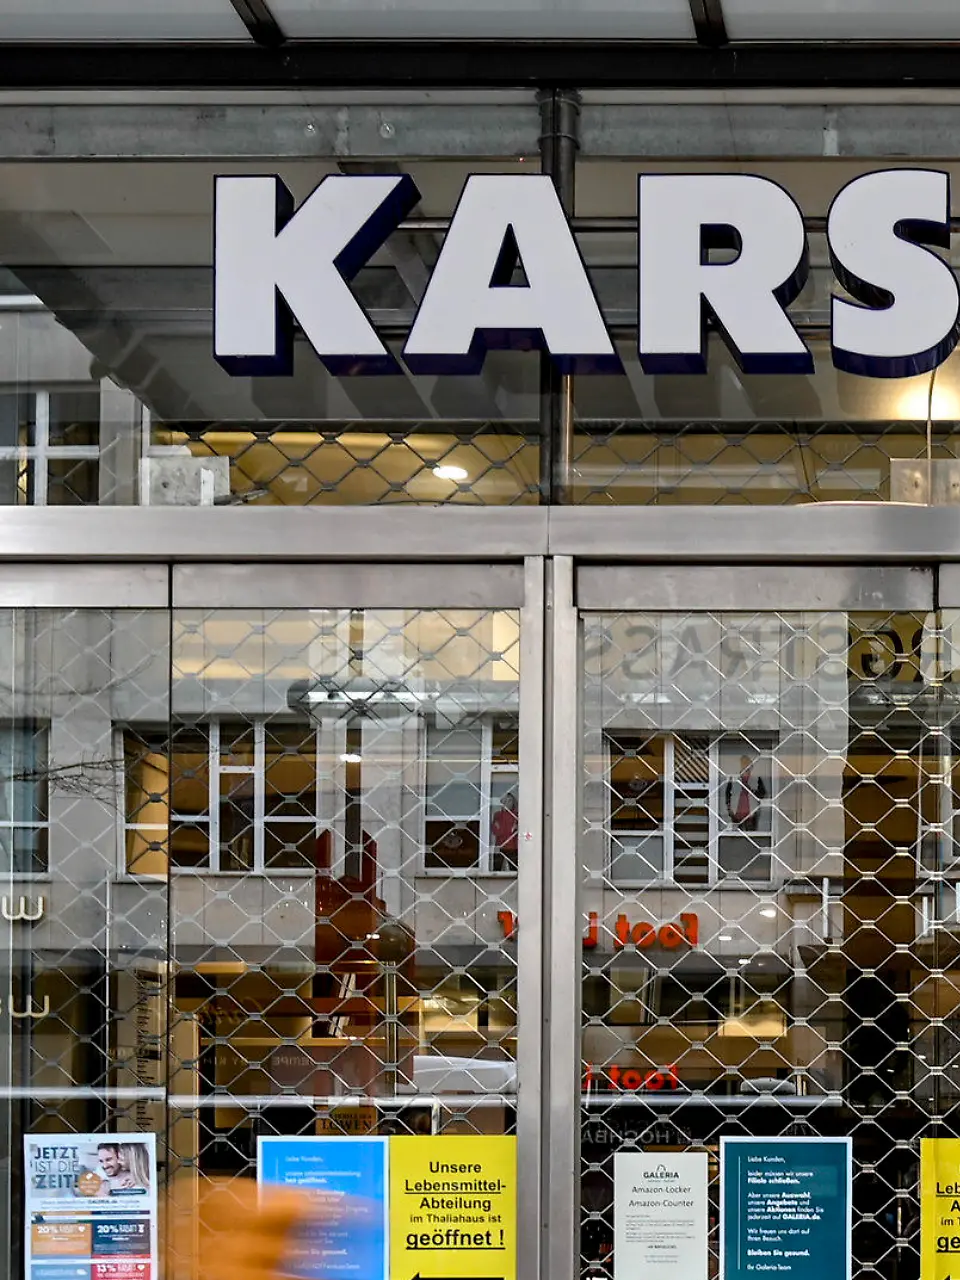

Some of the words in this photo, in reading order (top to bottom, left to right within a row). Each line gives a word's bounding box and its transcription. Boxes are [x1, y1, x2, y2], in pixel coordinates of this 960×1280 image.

[35, 1148, 78, 1159] JETZT
[35, 1161, 52, 1171] IST
[57, 1161, 79, 1171] DIE
[429, 1161, 482, 1173] Unsere
[36, 1175, 79, 1188] ZEIT!
[405, 1179, 506, 1192] Lebensmittel-
[420, 1197, 492, 1211] Abteilung
[410, 1214, 423, 1223] im
[426, 1214, 485, 1223] Thaliahaus
[488, 1214, 501, 1223] ist
[941, 1217, 954, 1226] im
[97, 1225, 118, 1233] 20%
[406, 1230, 493, 1249] geöffnet
